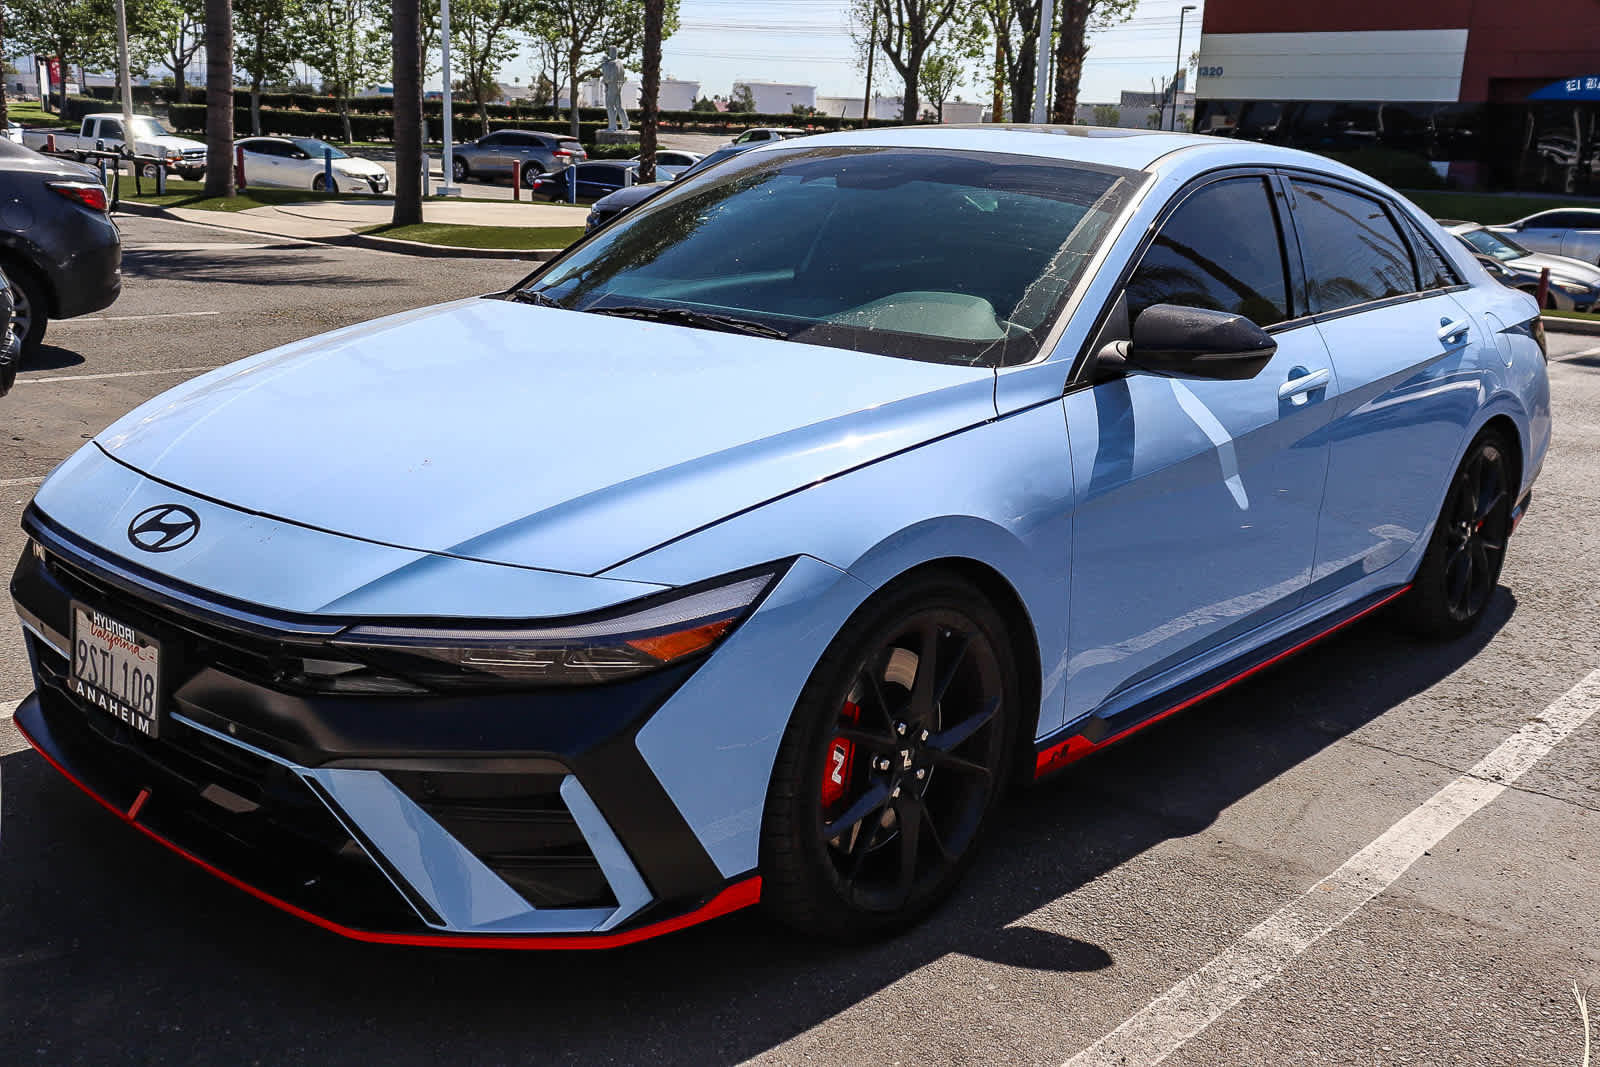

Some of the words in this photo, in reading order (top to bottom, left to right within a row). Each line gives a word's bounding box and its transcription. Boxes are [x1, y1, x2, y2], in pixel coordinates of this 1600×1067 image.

[93, 611, 135, 643] HYUNDAI
[78, 639, 154, 717] 9STL108
[75, 682, 149, 735] ANAHEIM
